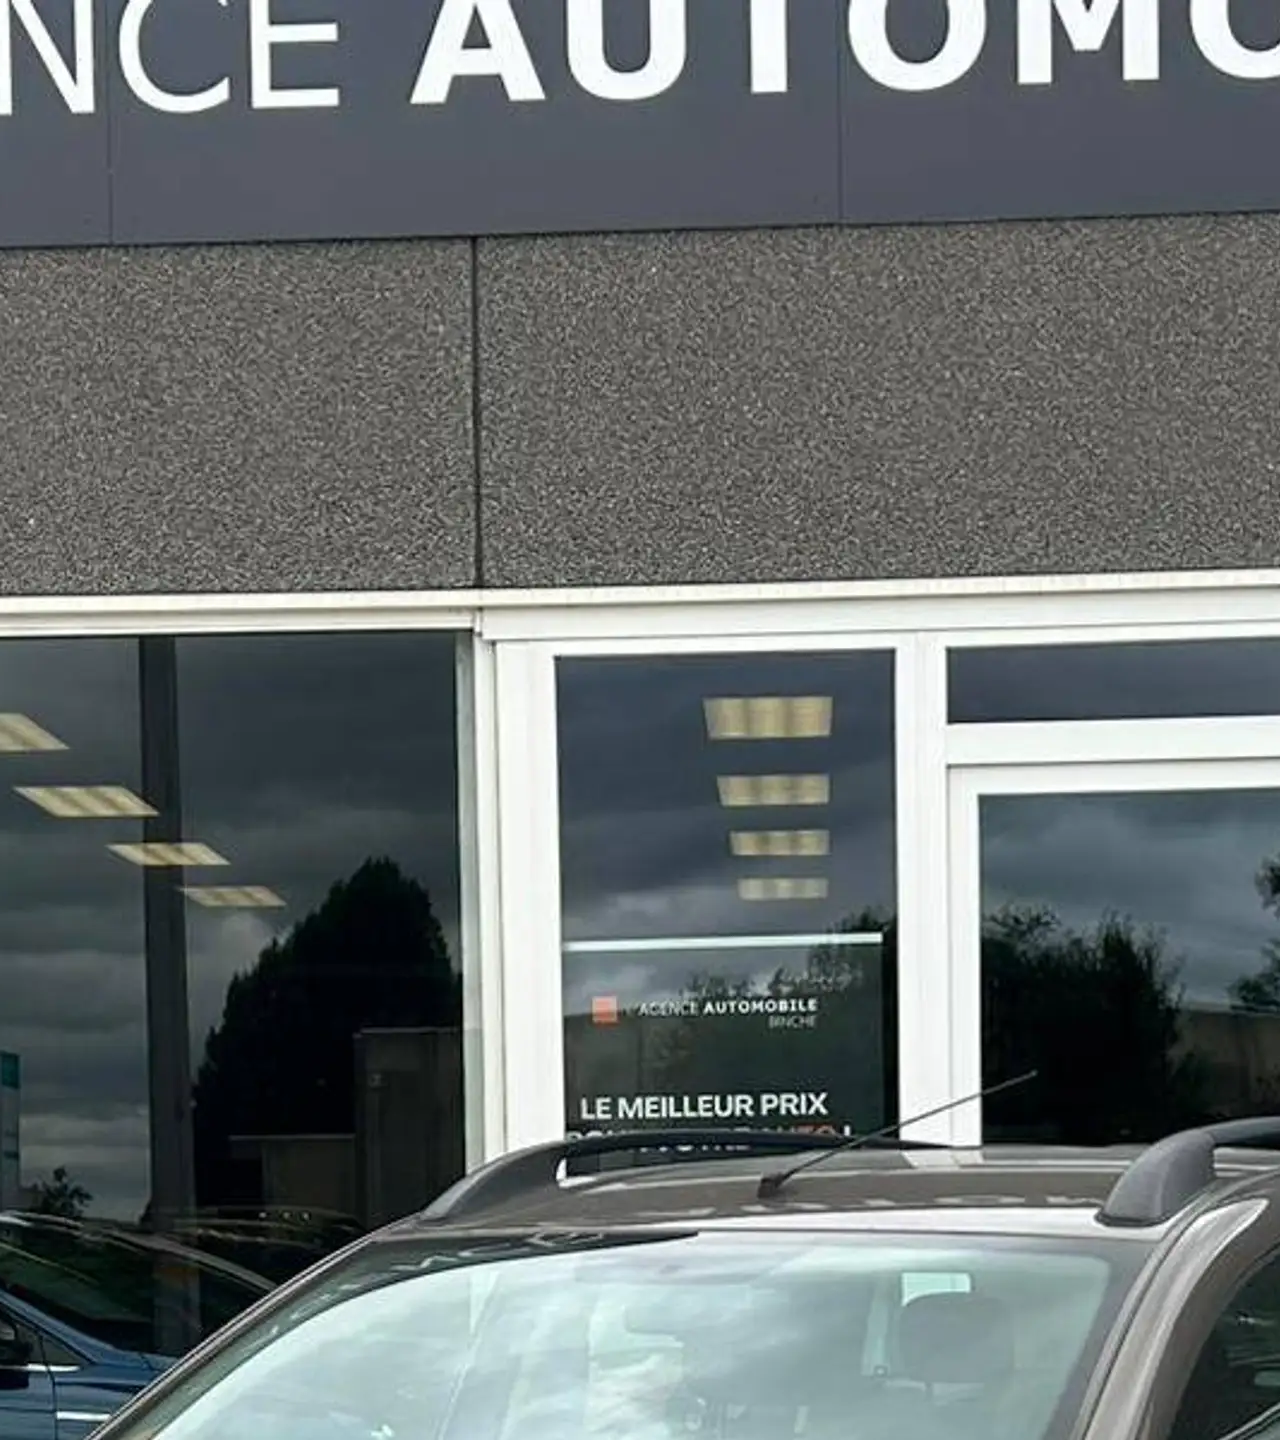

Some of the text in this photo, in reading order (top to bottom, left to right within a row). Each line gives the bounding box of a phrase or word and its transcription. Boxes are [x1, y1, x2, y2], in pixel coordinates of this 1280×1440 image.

[704, 998, 819, 1015] AUTOMOBILE
[580, 1092, 828, 1120] LE MEILLEUR PRIX
